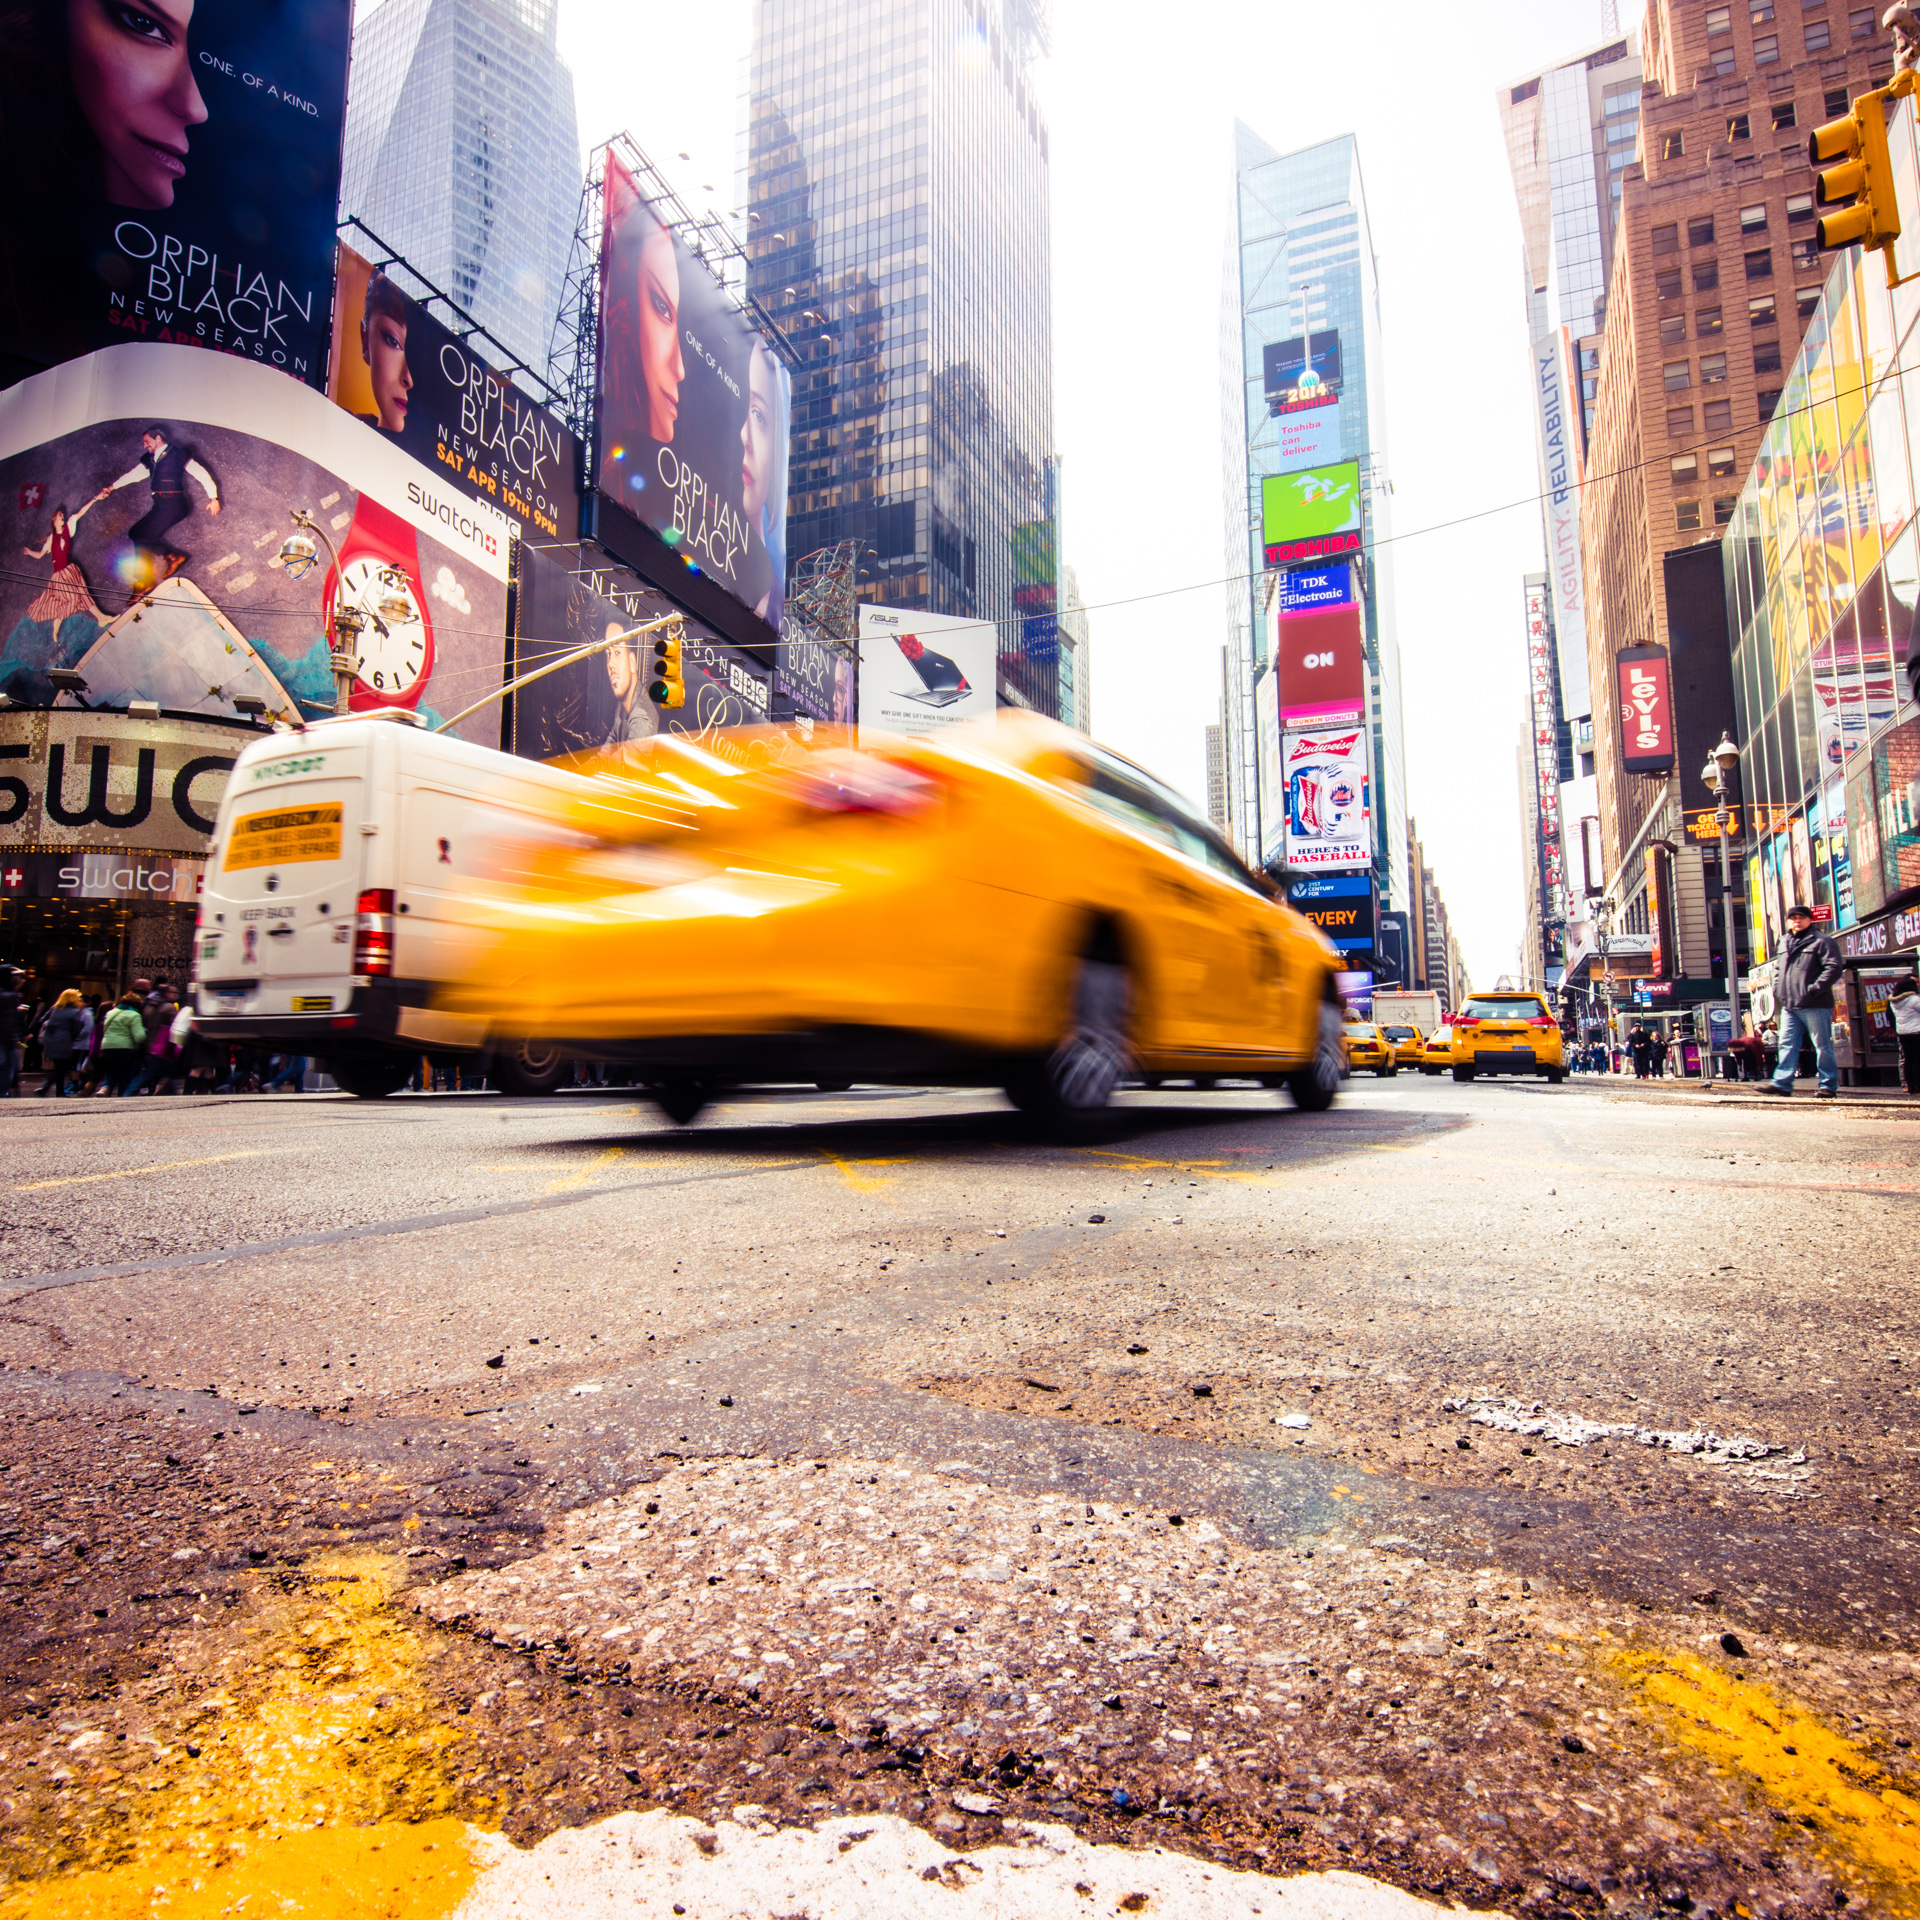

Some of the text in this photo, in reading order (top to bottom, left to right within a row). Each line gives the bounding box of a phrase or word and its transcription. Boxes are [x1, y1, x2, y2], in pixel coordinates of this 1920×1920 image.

[199, 51, 320, 118] ONE. OF A KIND.
[115, 221, 312, 323] ORPHAN
[148, 264, 288, 346] BLACK
[108, 308, 150, 334] SAT
[111, 291, 174, 324] NEW
[195, 322, 307, 372] SEASON
[706, 352, 716, 369] OF
[717, 365, 723, 376] A
[440, 344, 560, 465] ORPHAN
[1278, 394, 1338, 415] TOSHIBA
[1288, 382, 1327, 403] 2014
[461, 392, 547, 489] BLACK
[1281, 420, 1321, 435] Toshiba
[1282, 436, 1300, 446] can
[1539, 347, 1569, 506] RELIABILITY.
[1282, 443, 1318, 456] deliver
[438, 423, 478, 462] NEW
[491, 462, 558, 519] SEASON
[436, 442, 463, 472] SAT
[467, 465, 496, 496] APR
[502, 486, 530, 518] 19TH
[534, 509, 557, 537] 9PM
[658, 446, 748, 555] ORPHAN
[408, 481, 484, 547] swatch
[672, 494, 738, 580] BLACK
[1266, 533, 1360, 563] TOSHIBA
[1555, 509, 1580, 611] AGILITY.
[592, 571, 638, 616] NEW
[1288, 588, 1343, 605] Electronic
[1301, 575, 1328, 589] TDK
[869, 613, 899, 624] ASUS
[780, 616, 830, 675] ORPHAN
[1303, 651, 1335, 669] ON
[1530, 597, 1547, 704] ERNST
[373, 670, 384, 689] 6
[789, 645, 824, 693] BLACK
[730, 663, 767, 710] BBC
[780, 669, 829, 711] NEW SEASON
[780, 680, 791, 696] SAT
[792, 689, 804, 705] APR
[806, 701, 818, 715] 19TH
[1293, 713, 1356, 725] DUNKIN' DONUTS
[1538, 729, 1552, 746] &
[1541, 769, 1561, 885] YOUNG
[1686, 822, 1722, 832] TICKETS
[1697, 813, 1716, 824] GE
[1696, 829, 1722, 839] HERE
[1288, 851, 1371, 864] BASEBALL
[1297, 844, 1360, 855] HERE'S TO
[57, 865, 192, 893] swatch
[1305, 909, 1358, 926] EVERY
[1904, 910, 1920, 940] ELE
[1865, 982, 1898, 1003] JERS
